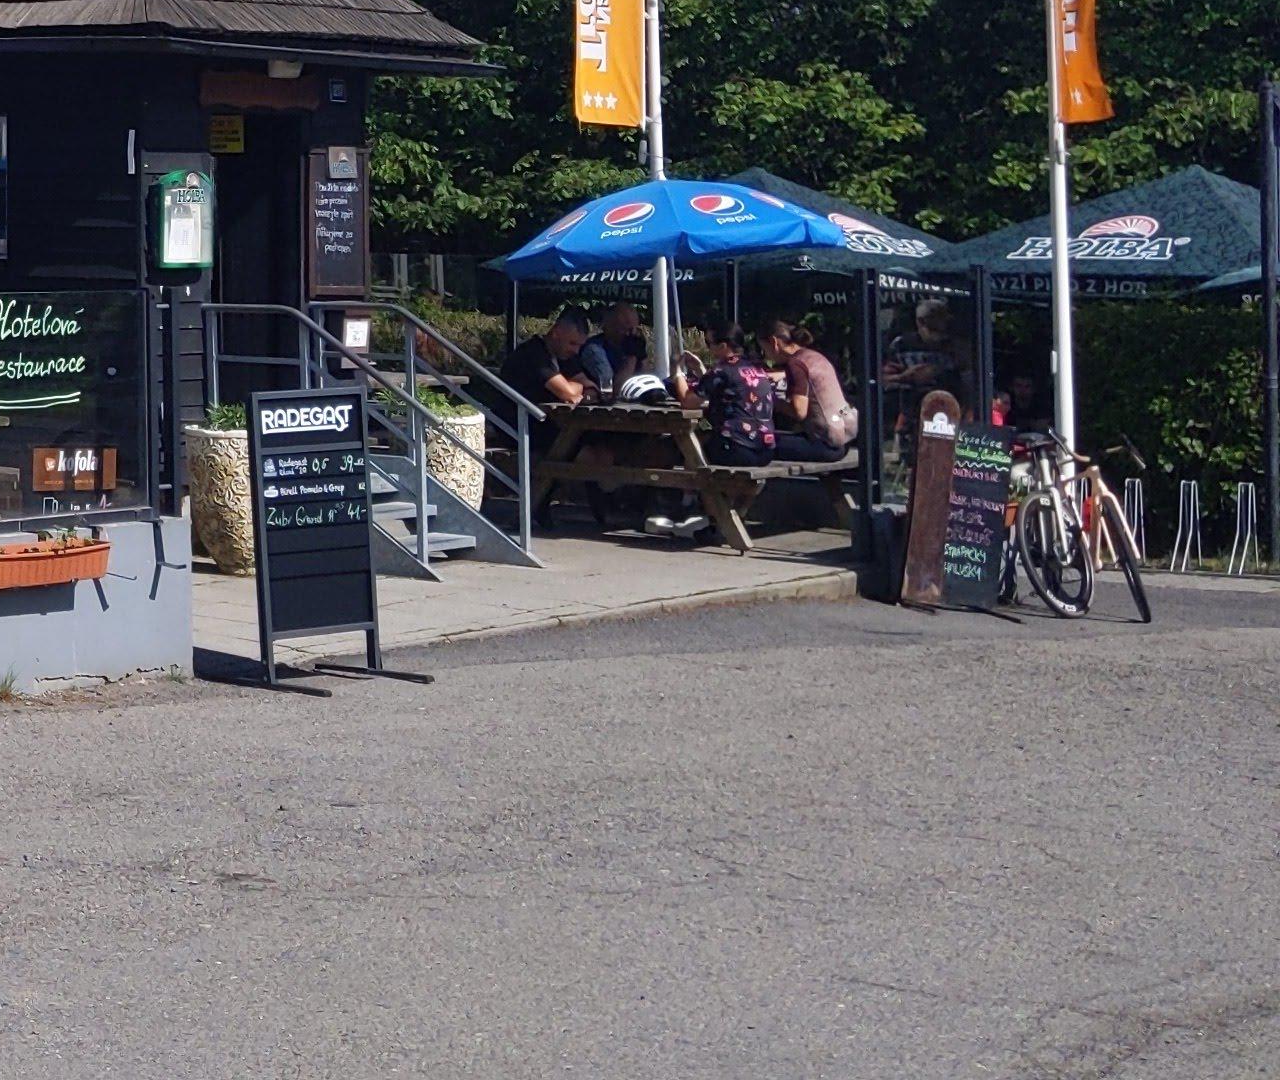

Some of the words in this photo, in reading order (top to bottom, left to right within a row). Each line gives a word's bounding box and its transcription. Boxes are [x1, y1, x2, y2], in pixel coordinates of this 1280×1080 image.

[716, 213, 757, 225] pepsi
[601, 225, 643, 239] pepsi
[1006, 237, 1176, 260] HOLBA
[600, 269, 639, 281] PIVO
[1086, 280, 1097, 292] Z
[261, 405, 353, 434] RADEGAST
